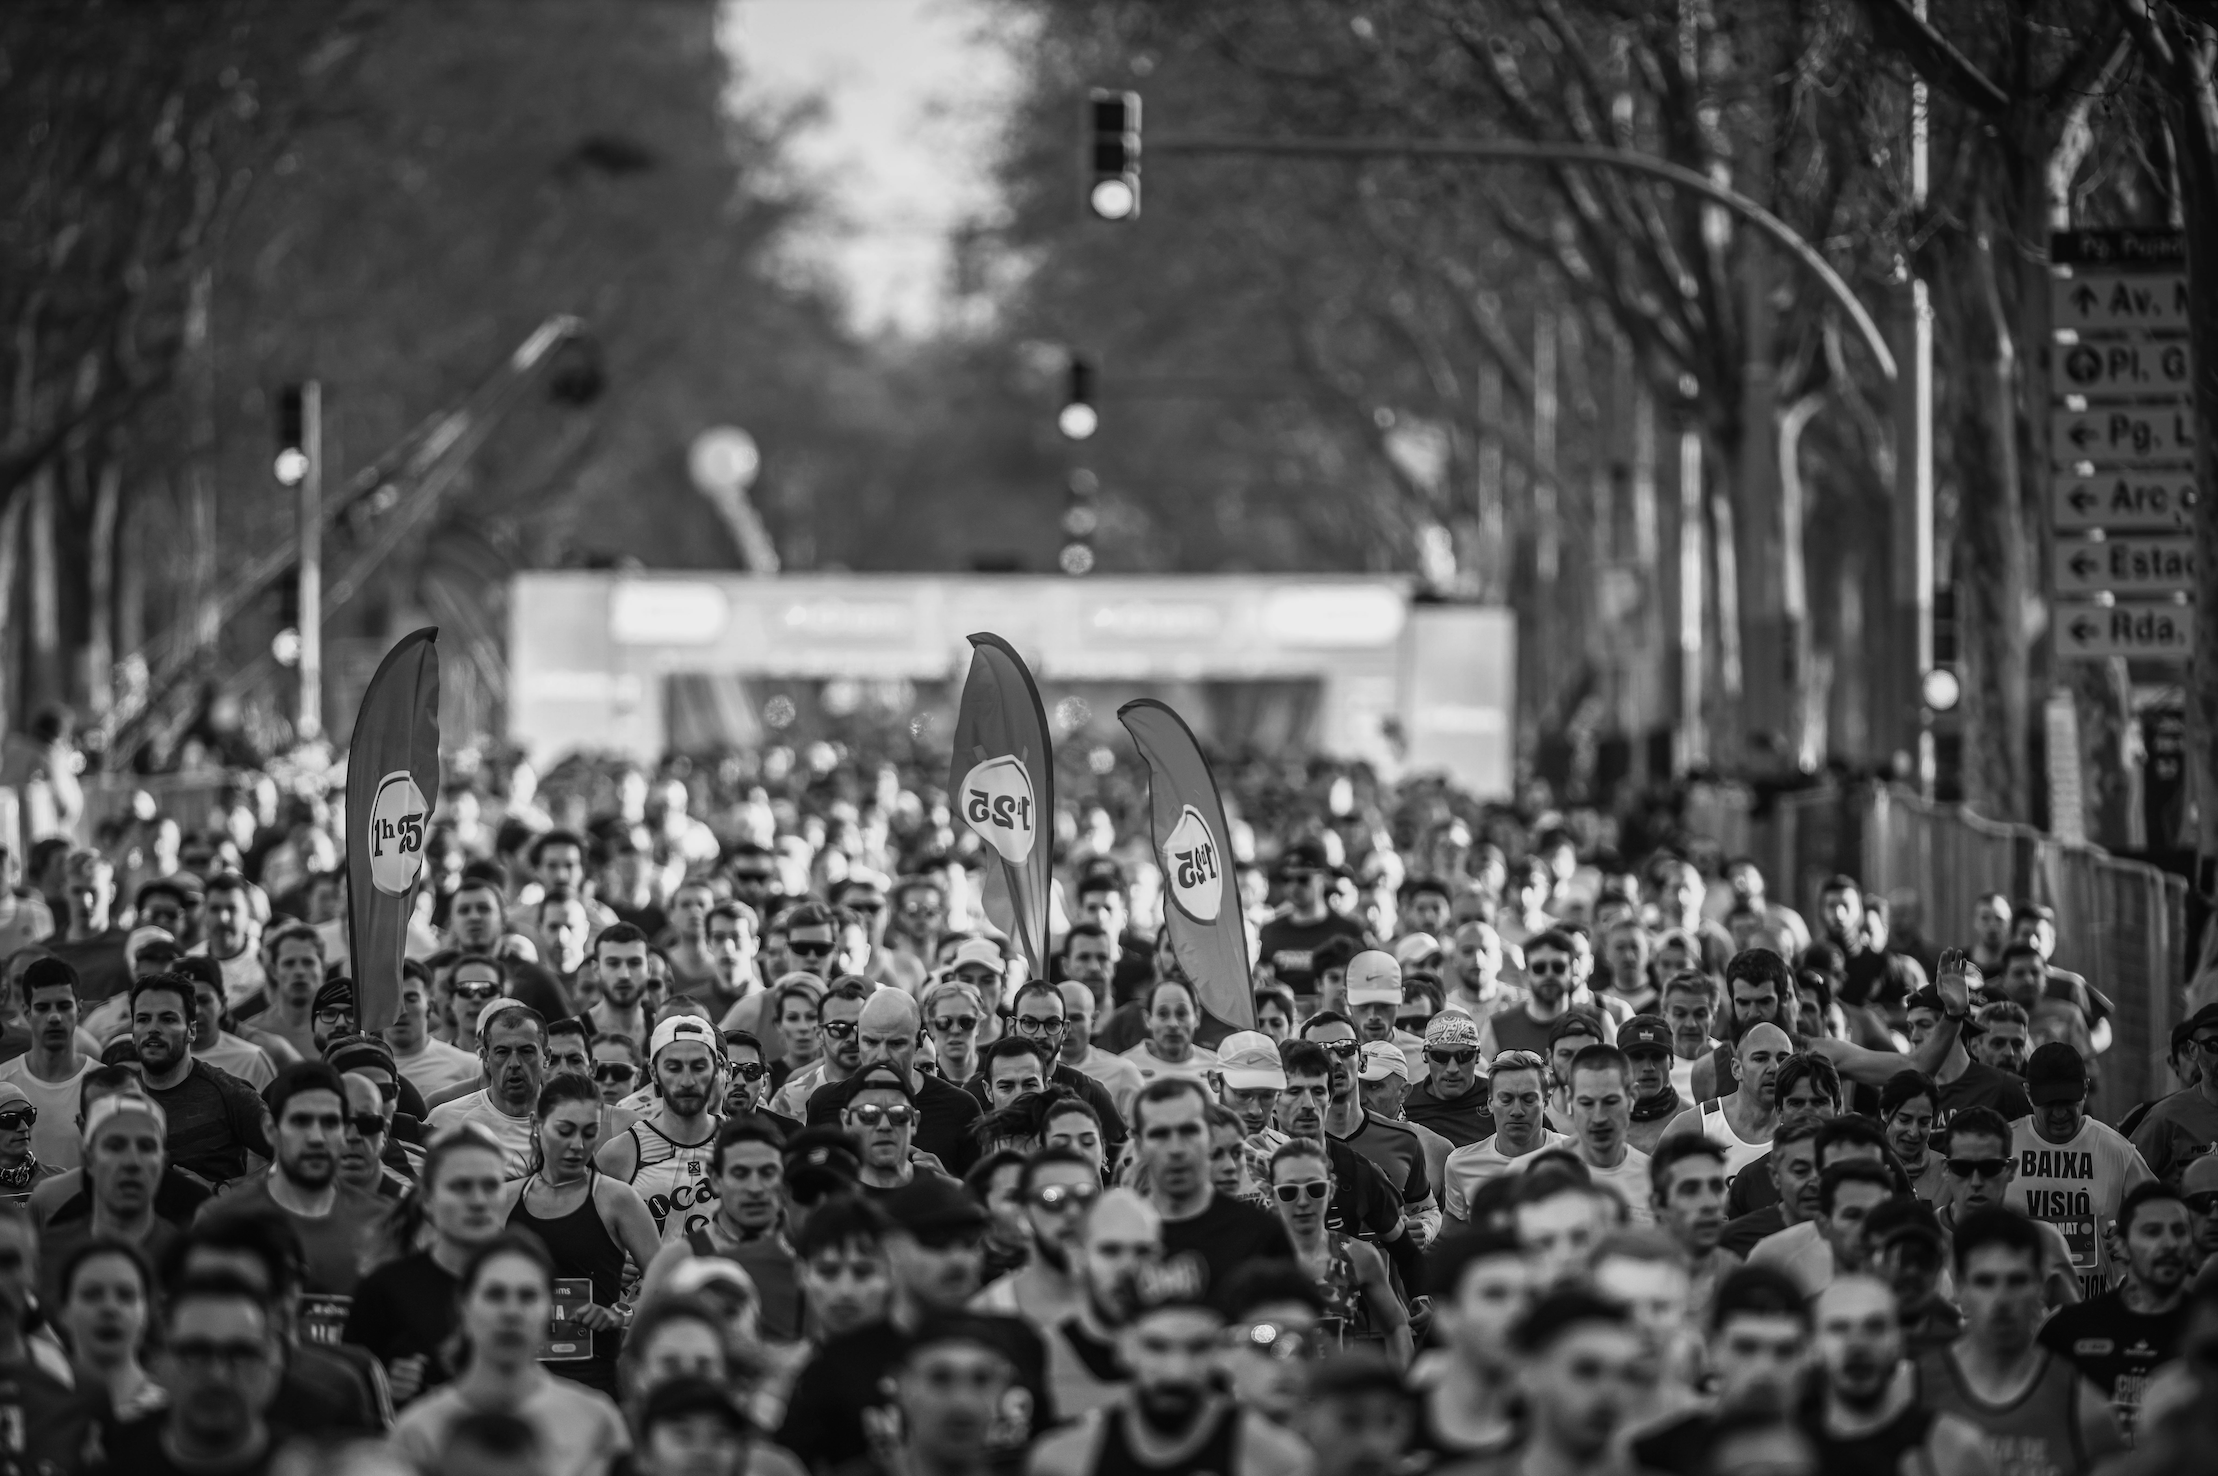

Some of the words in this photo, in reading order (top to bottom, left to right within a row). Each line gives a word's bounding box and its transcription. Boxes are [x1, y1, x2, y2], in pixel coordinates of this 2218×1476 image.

[2109, 280, 2162, 317] Av.
[2110, 413, 2162, 455] Pg.
[2110, 479, 2168, 515] Arc
[2111, 610, 2186, 645] Rda.
[2021, 1150, 2094, 1179] BAIXA
[2026, 1187, 2091, 1217] VISIÓ
